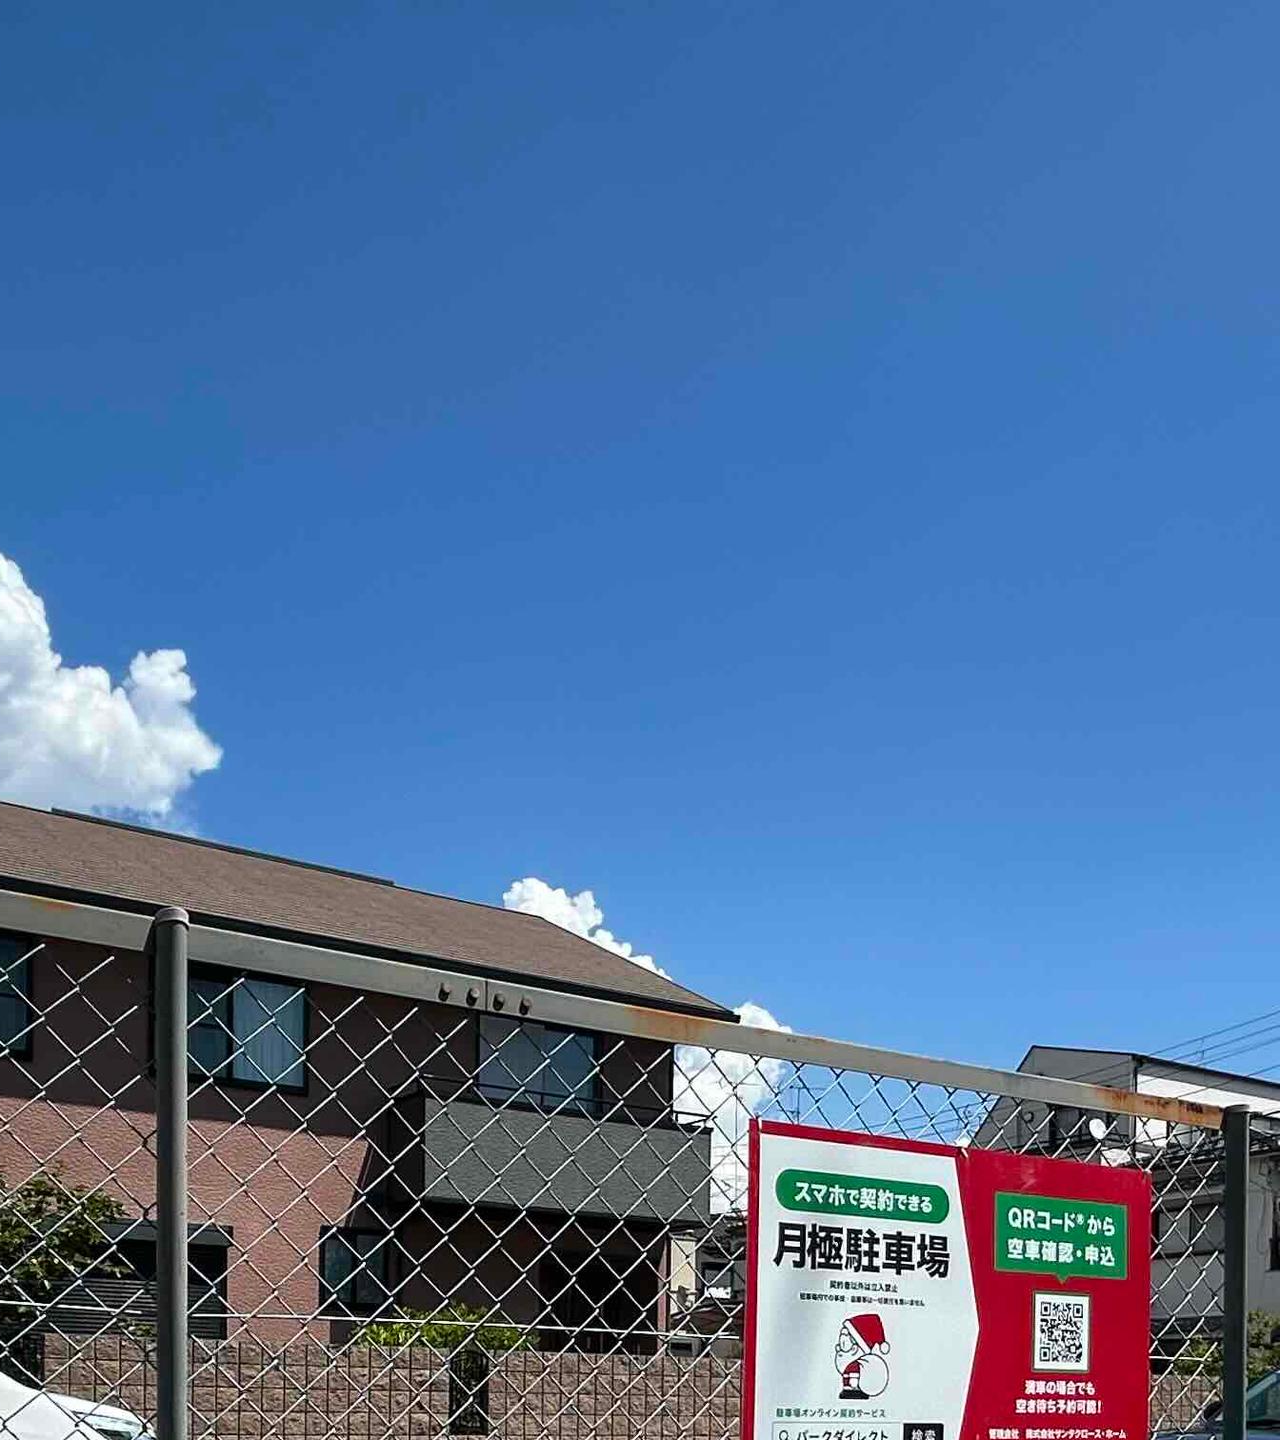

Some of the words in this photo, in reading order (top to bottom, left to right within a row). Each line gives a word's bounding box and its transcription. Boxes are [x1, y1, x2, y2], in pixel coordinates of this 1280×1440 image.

[794, 1182, 933, 1213] スマホで契約できる
[773, 1222, 951, 1278] 月極駐車場
[1007, 1238, 1115, 1267] 空車確認・申込
[1024, 1380, 1096, 1395] 満車の場合でも
[776, 1408, 885, 1418] 駐車場オンライン契約サービス
